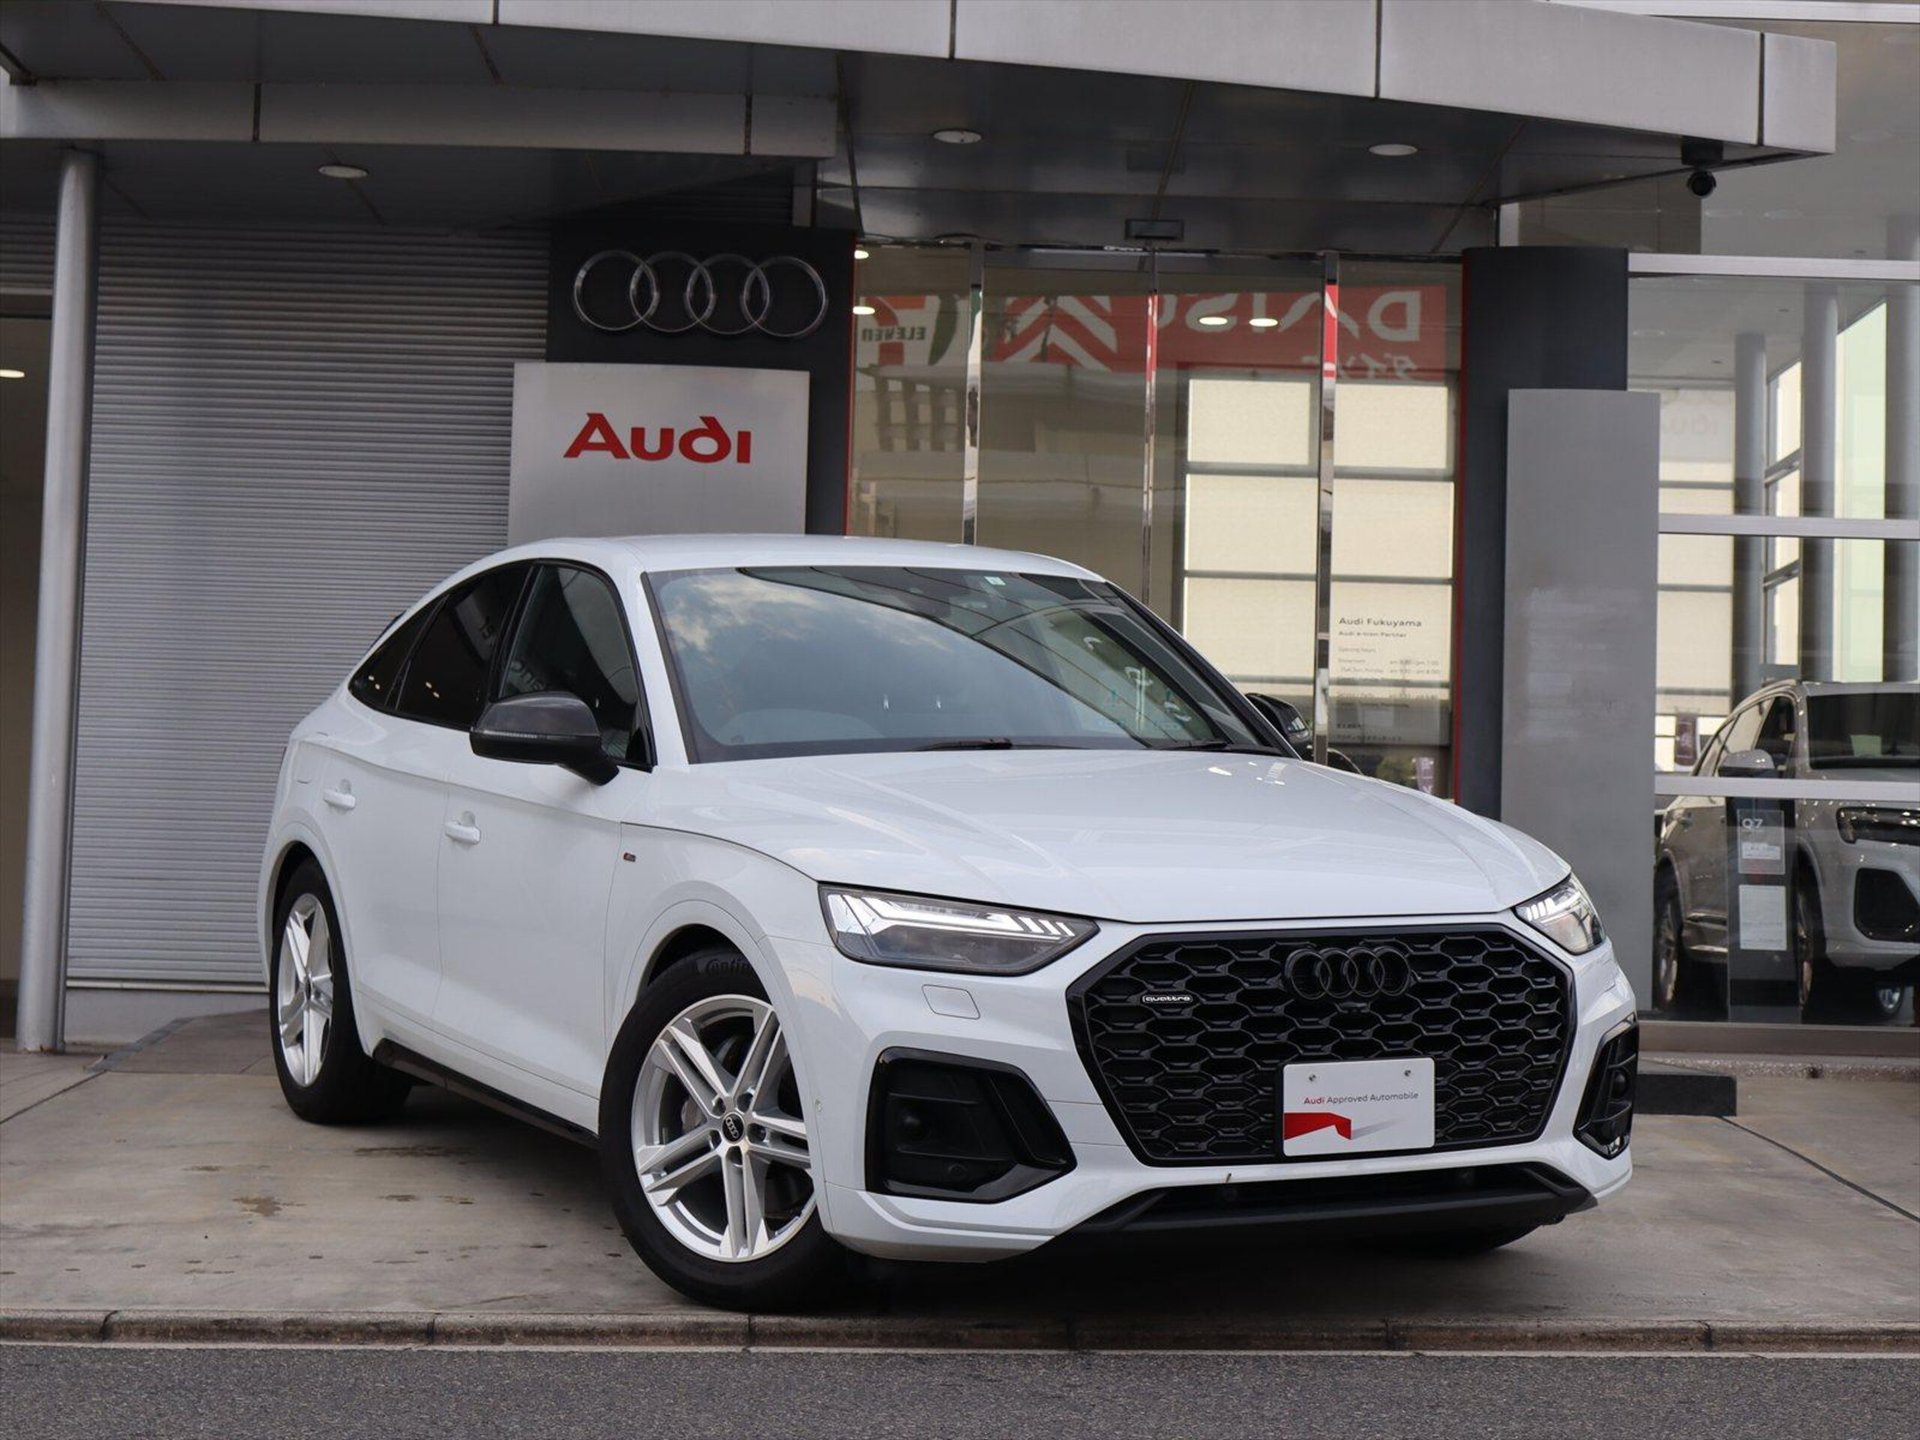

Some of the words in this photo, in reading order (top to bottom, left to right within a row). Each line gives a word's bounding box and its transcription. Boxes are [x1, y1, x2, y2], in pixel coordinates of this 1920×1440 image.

[563, 412, 752, 464] Audi
[1339, 617, 1364, 625] Audi
[1366, 617, 1422, 628] Fukuyama
[1741, 817, 1764, 830] Q7
[1145, 995, 1191, 1003] quattro
[1304, 1096, 1325, 1105] Audi
[1326, 1094, 1368, 1105] Approved
[1369, 1091, 1419, 1102] Automobile
